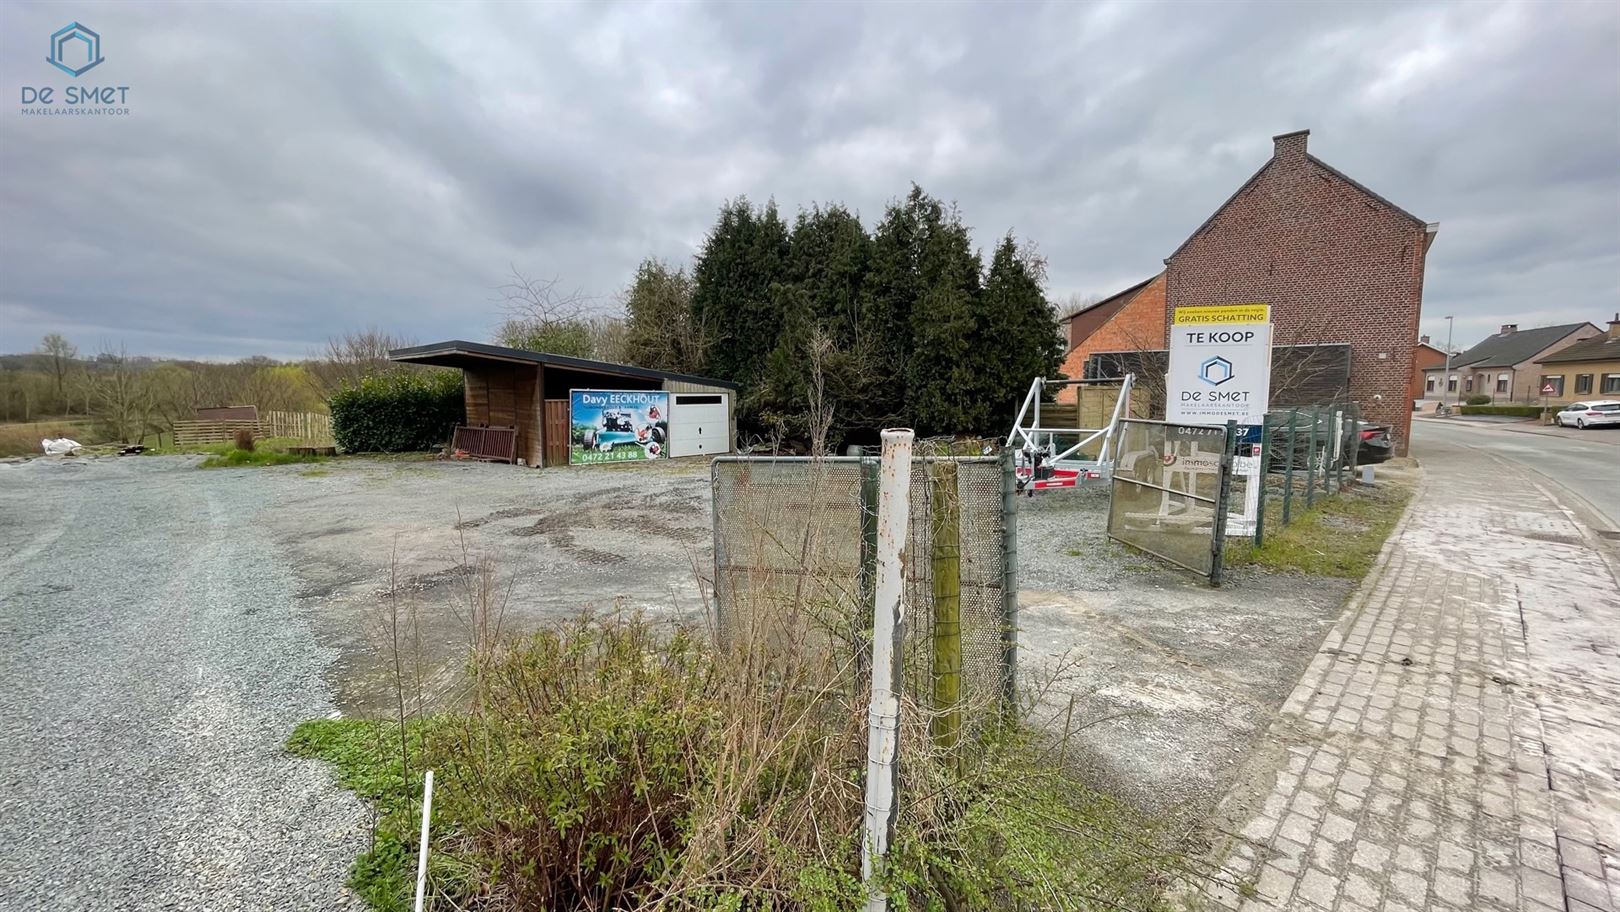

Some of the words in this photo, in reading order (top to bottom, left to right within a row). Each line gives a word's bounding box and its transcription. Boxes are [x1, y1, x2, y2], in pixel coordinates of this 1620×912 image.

[1211, 313, 1264, 321] SCHATTING
[1186, 332, 1205, 343] TE
[1208, 331, 1254, 343] KOOP
[582, 394, 608, 406] Davy
[610, 394, 660, 404] EECKHOUT
[1178, 426, 1204, 436] 0472
[1236, 428, 1250, 436] 37
[582, 453, 603, 462] 0472
[604, 452, 614, 460] 21
[616, 451, 626, 459] 43
[628, 451, 638, 459] 88
